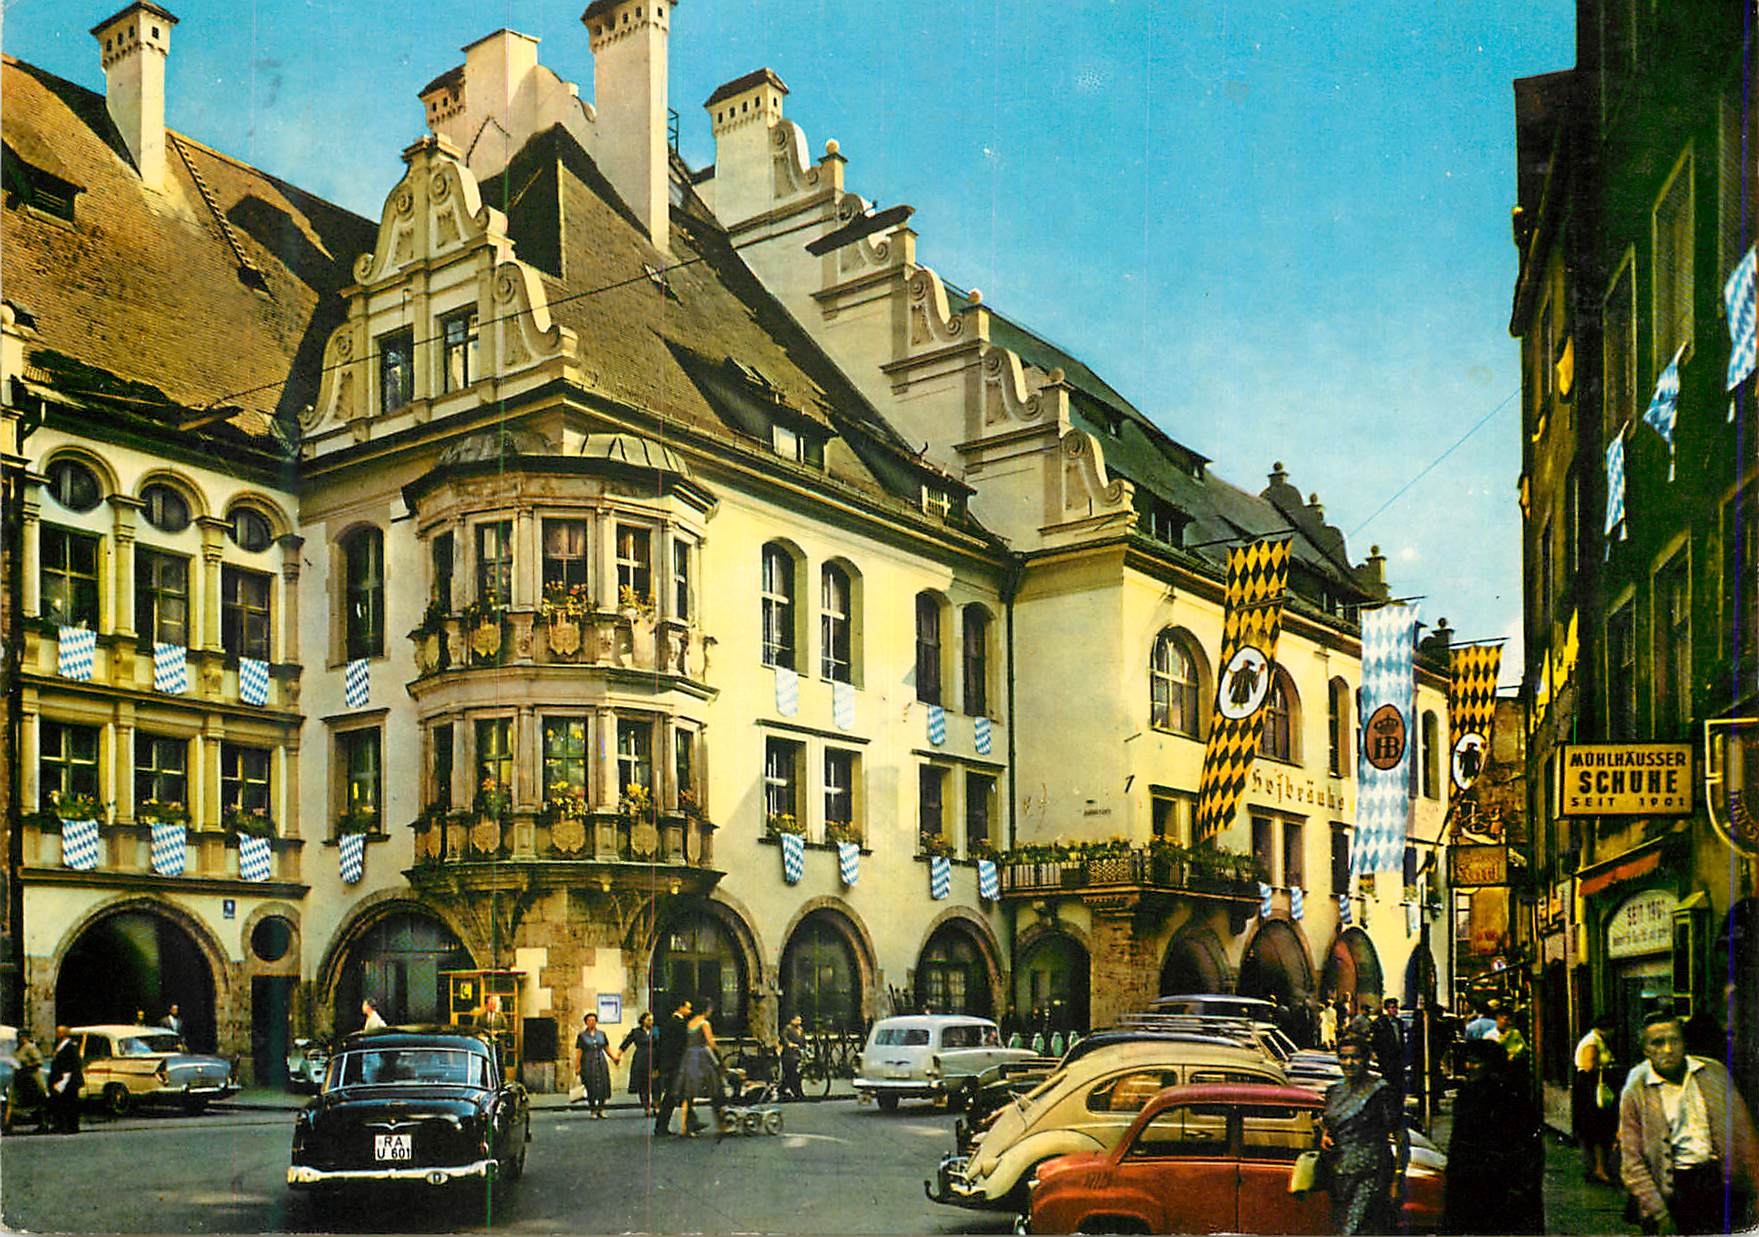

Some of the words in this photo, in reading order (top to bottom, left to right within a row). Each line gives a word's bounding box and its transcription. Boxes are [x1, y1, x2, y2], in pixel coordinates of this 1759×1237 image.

[1570, 752, 1686, 767] MÜHLHÄUSSER
[1579, 770, 1678, 794] SCHUHE
[1571, 797, 1616, 807] SEIT
[1639, 797, 1684, 807] 1901
[384, 1136, 403, 1147] RA
[377, 1148, 385, 1159] U
[391, 1148, 410, 1159] 601
